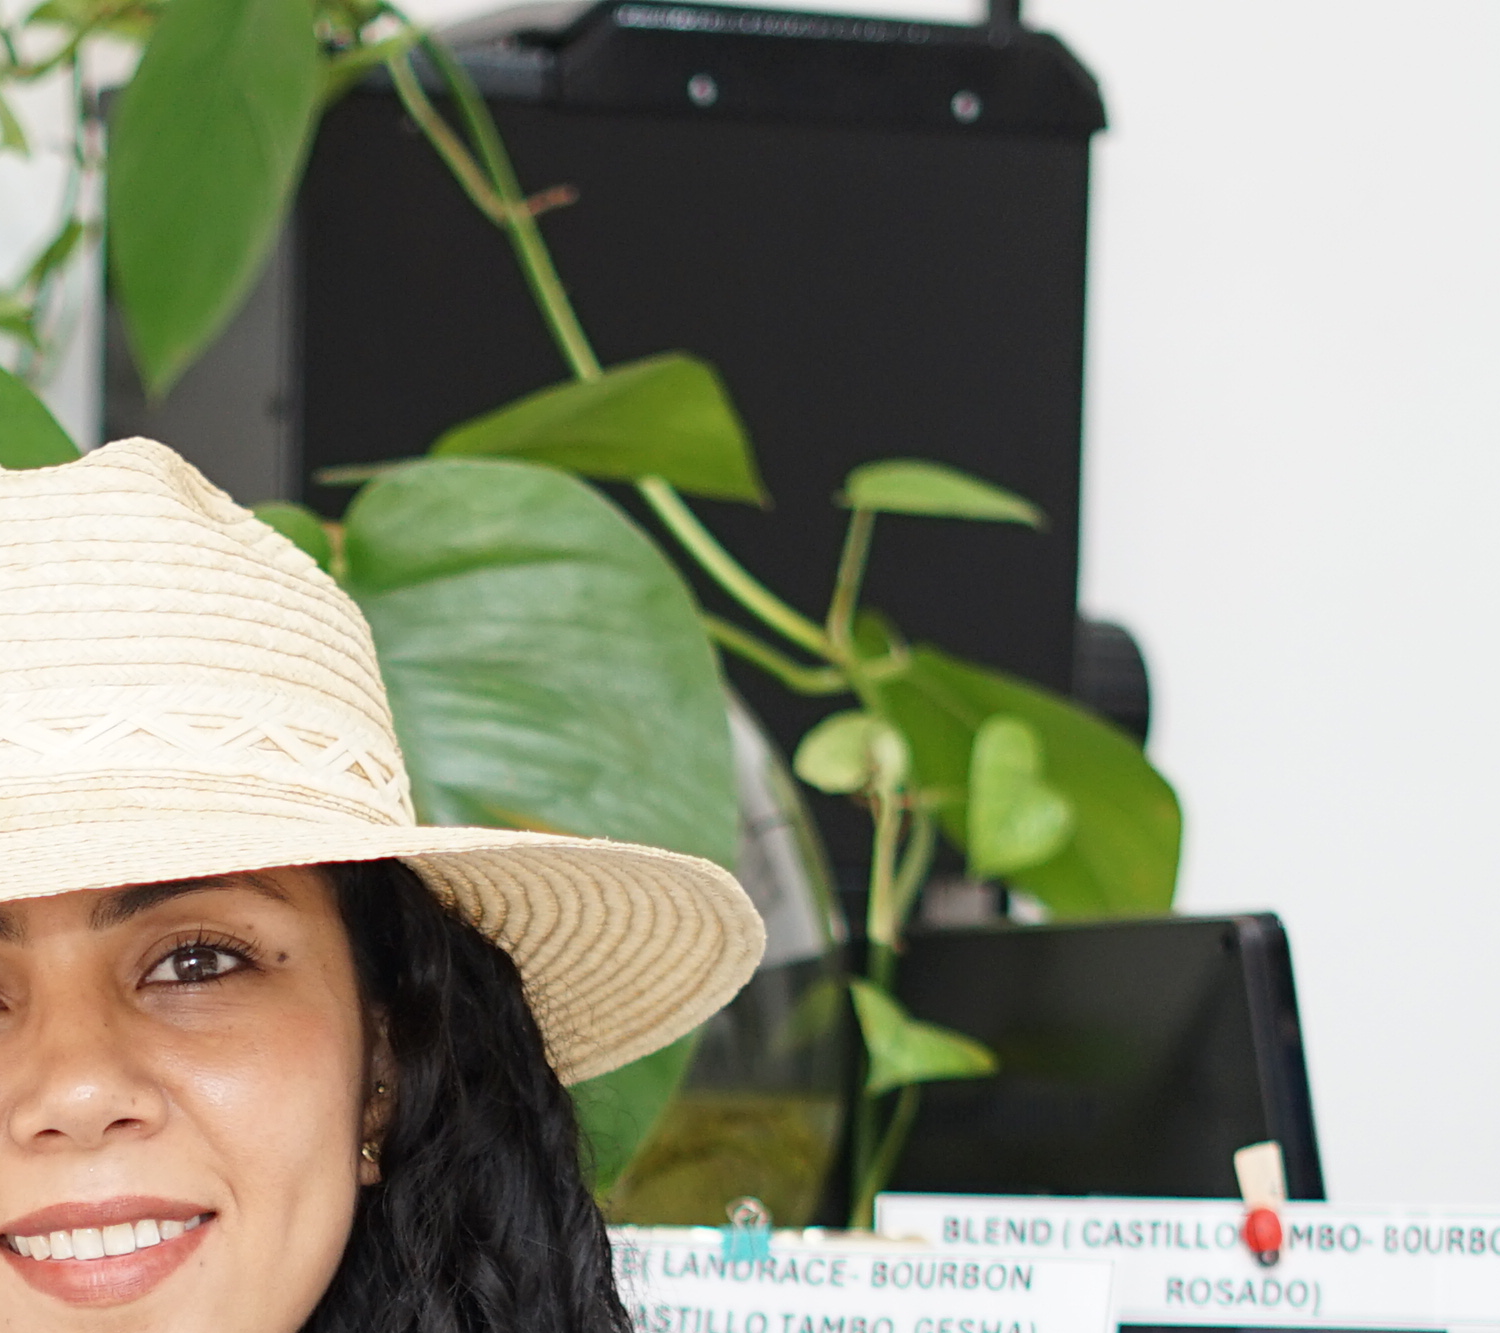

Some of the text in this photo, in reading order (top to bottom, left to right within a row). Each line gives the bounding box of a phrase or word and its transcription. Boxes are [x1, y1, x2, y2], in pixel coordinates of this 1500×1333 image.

[942, 1217, 1053, 1247] BLEND
[1082, 1219, 1239, 1250] CASTILLO
[1288, 1223, 1374, 1252] MBO-
[870, 1260, 1033, 1292] BOURBON
[1165, 1277, 1323, 1316] ROSADO)
